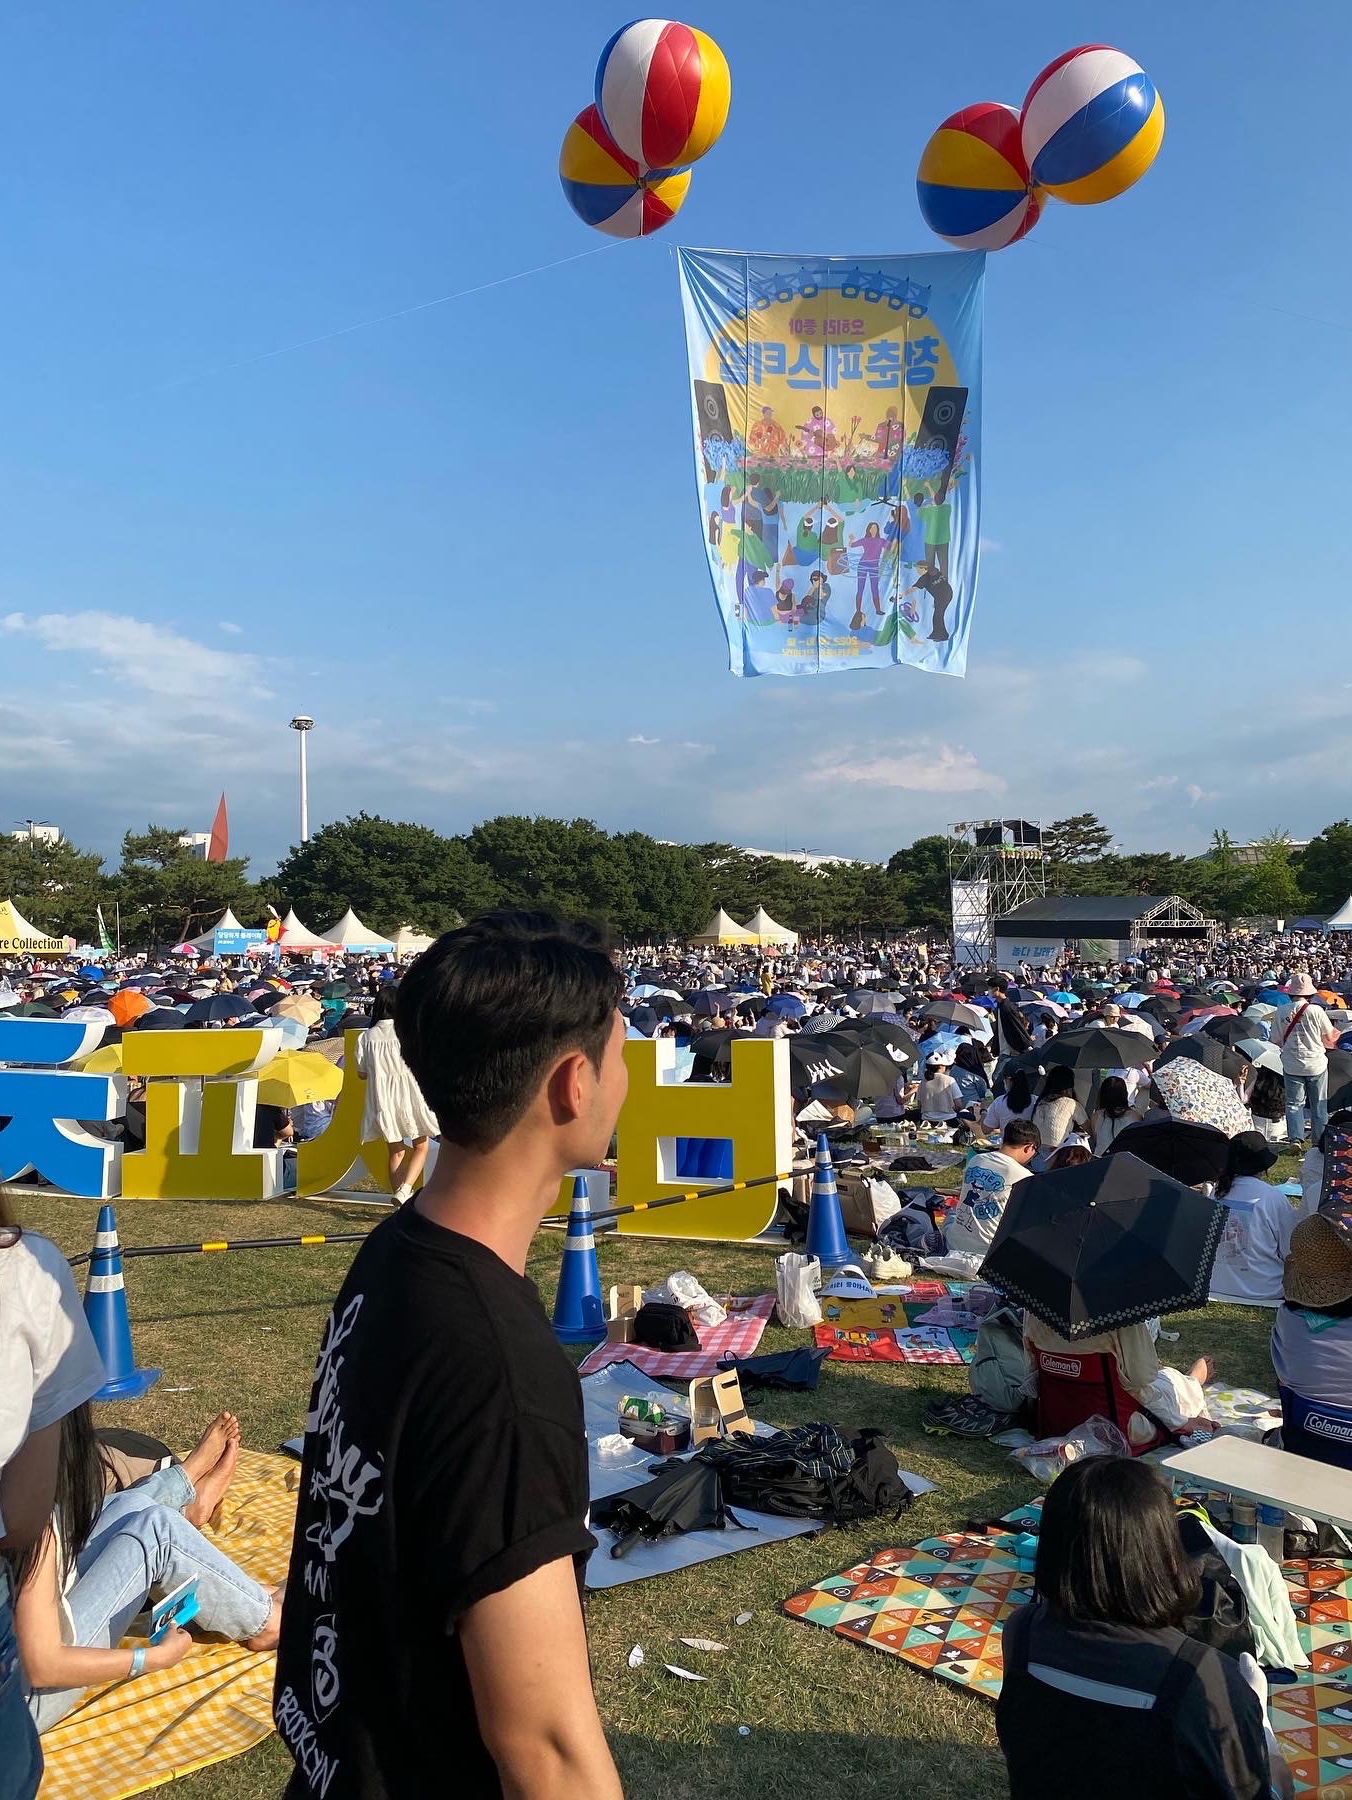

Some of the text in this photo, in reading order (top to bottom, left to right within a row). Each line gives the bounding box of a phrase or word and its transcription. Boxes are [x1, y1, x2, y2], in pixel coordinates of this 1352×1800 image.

[12, 937, 63, 950] Collection
[978, 1206, 998, 1217] BOY
[1042, 1355, 1071, 1371] Coleman
[1309, 1415, 1352, 1437] Coleman
[275, 1685, 340, 1800] BROOKLYN
